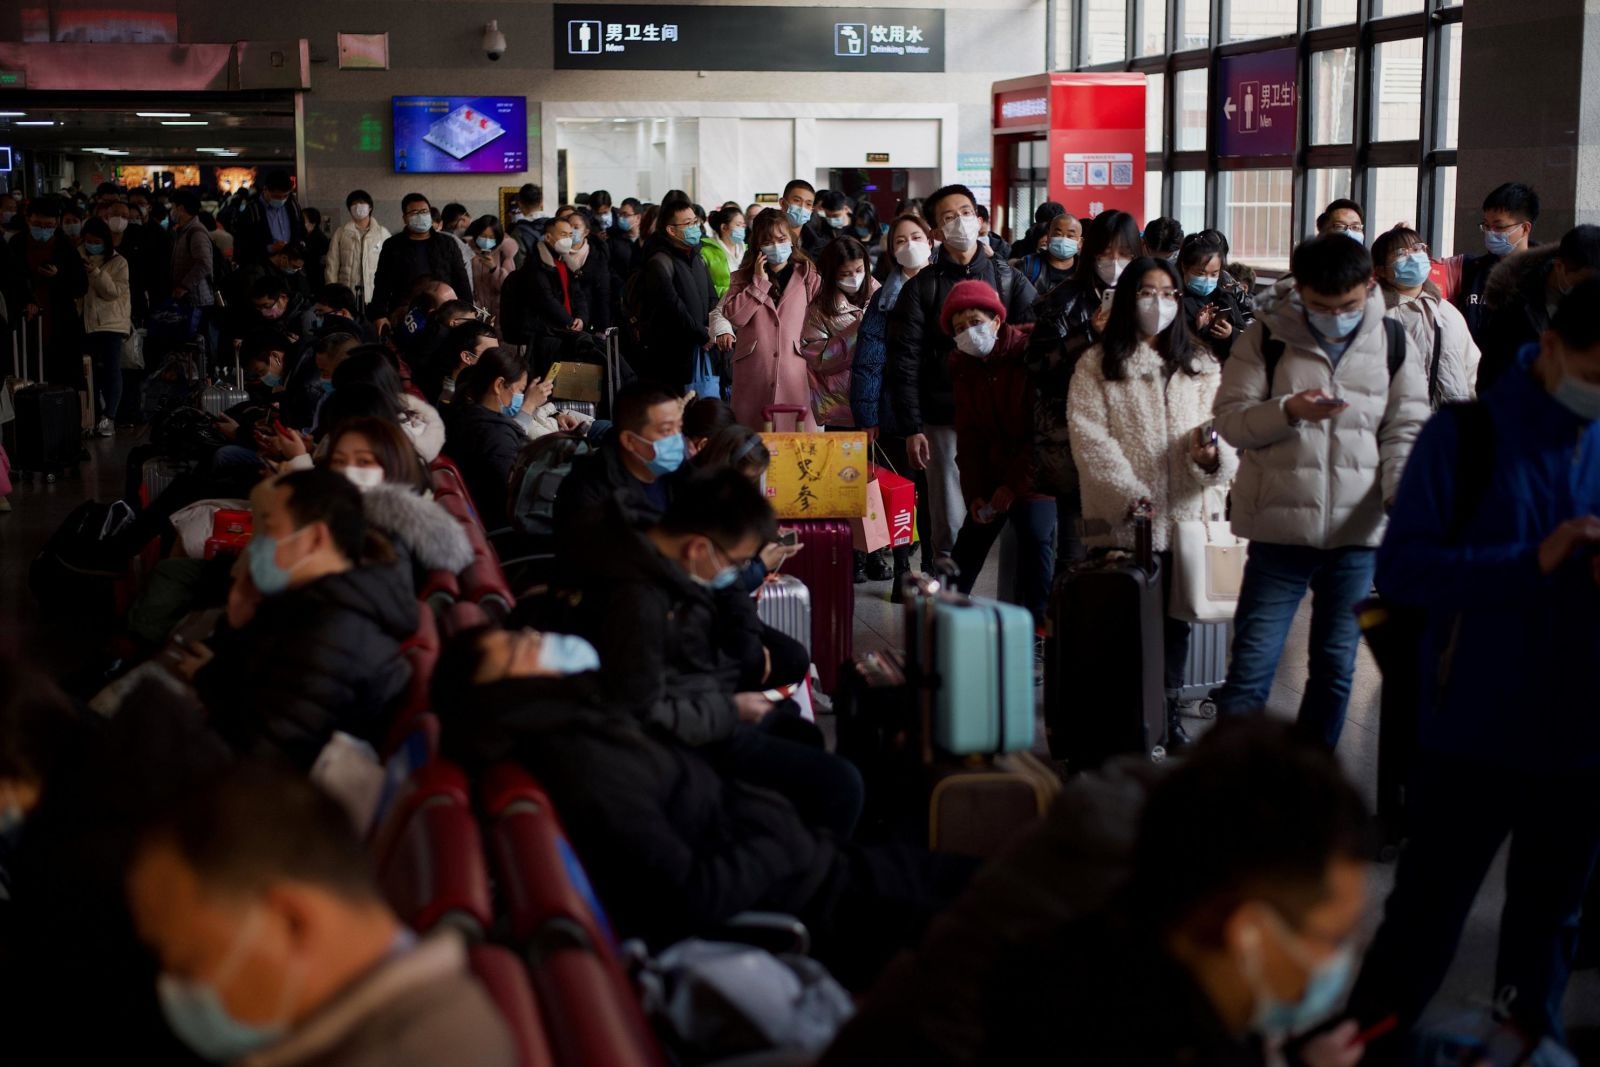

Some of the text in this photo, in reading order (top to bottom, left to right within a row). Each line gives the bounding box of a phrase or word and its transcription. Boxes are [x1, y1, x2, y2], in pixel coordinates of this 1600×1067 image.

[605, 23, 679, 42] 男卫生间
[870, 25, 924, 43] 饮用水
[605, 43, 625, 52] Men
[870, 45, 930, 55] Drinking Water
[1260, 114, 1273, 128] Men
